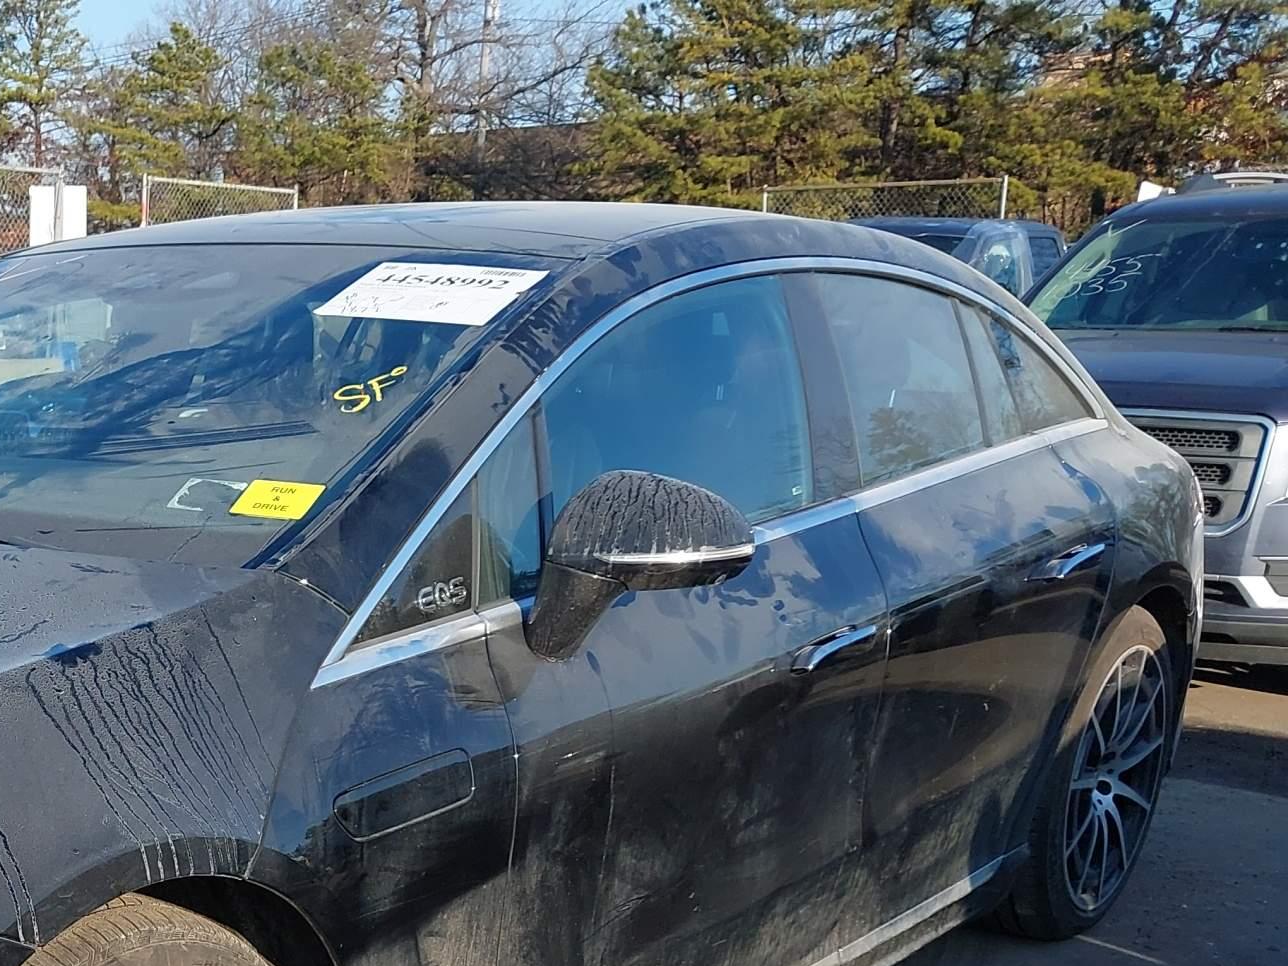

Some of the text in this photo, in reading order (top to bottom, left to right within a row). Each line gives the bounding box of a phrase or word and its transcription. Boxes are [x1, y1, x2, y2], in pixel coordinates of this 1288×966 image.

[376, 273, 511, 290] 44548992
[271, 485, 297, 495] RUN
[252, 501, 289, 512] DRIVE
[418, 576, 466, 612] EQS
